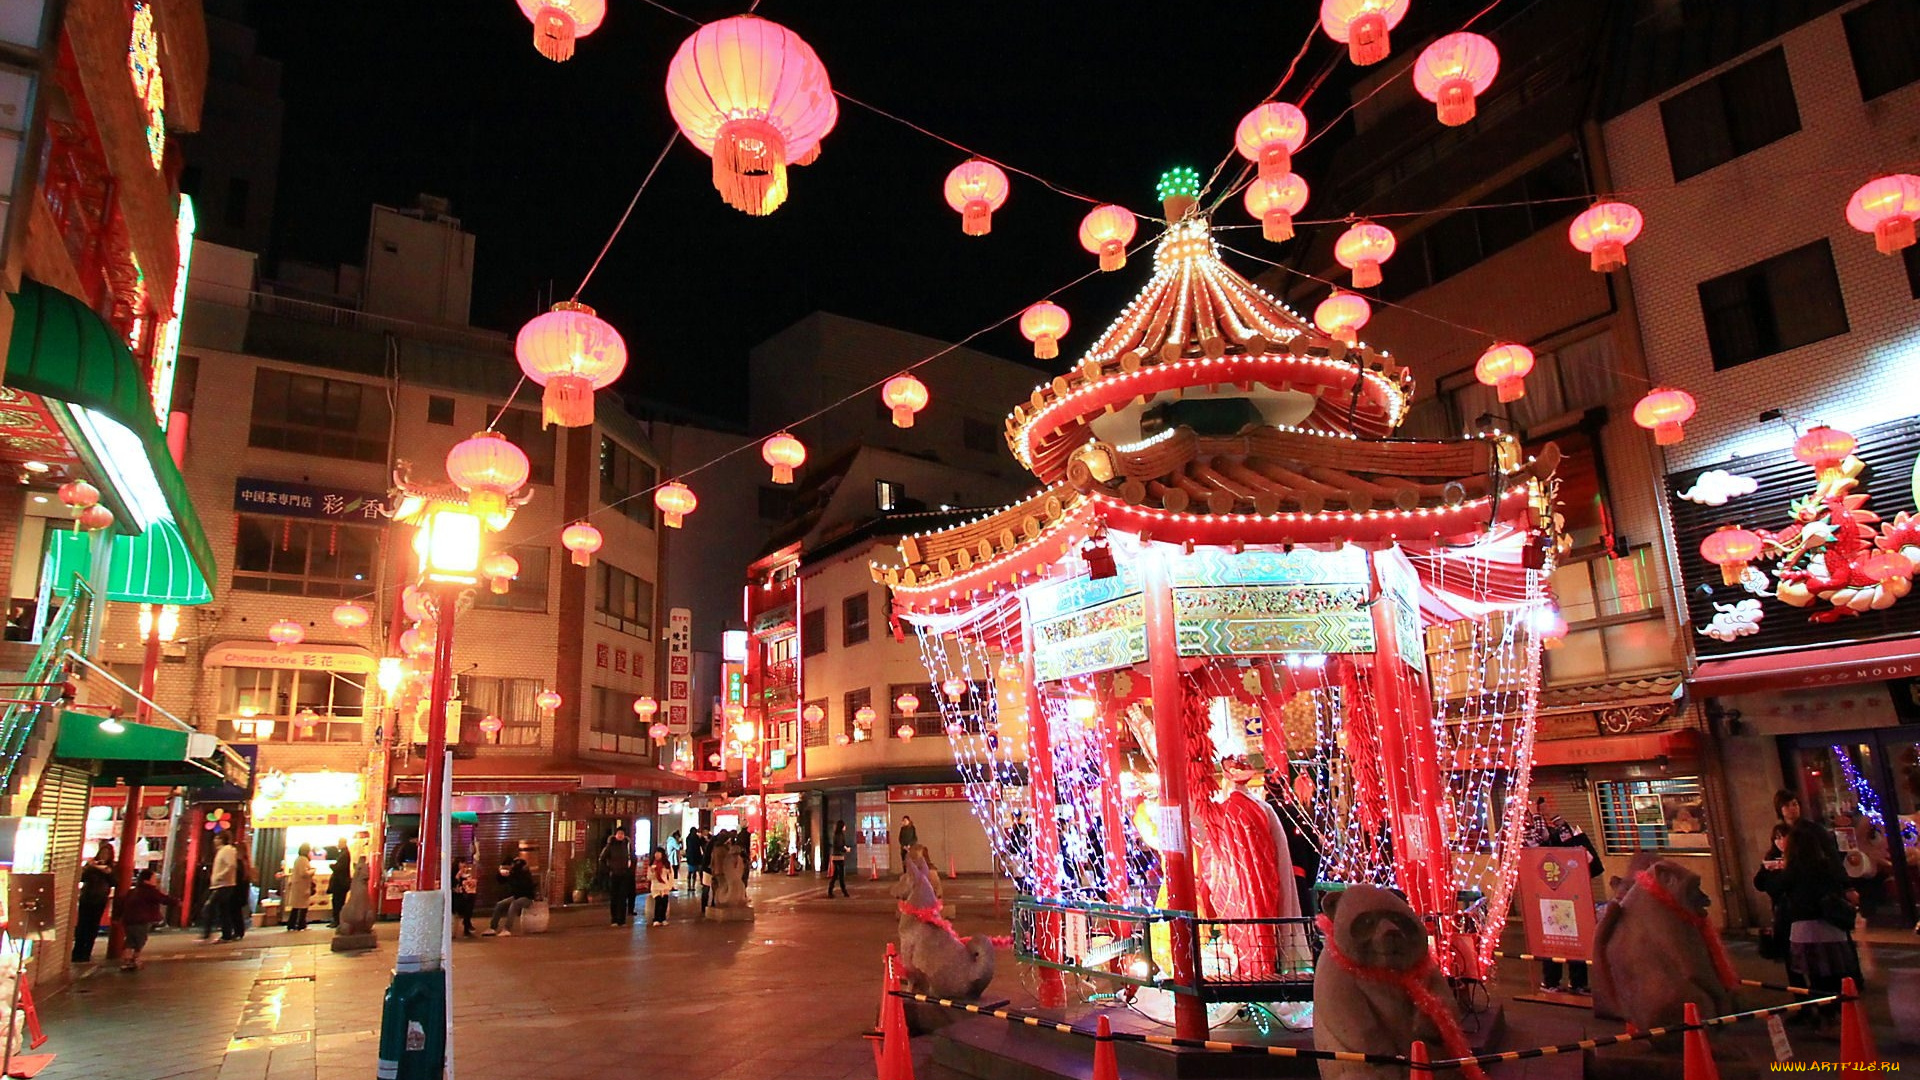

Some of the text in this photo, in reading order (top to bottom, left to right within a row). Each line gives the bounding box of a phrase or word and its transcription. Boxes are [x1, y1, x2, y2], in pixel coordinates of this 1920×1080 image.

[241, 489, 312, 508] 中国茶専門店
[224, 653, 267, 663] Chinese
[270, 656, 296, 664] Cafe
[1857, 664, 1912, 677] MOON
